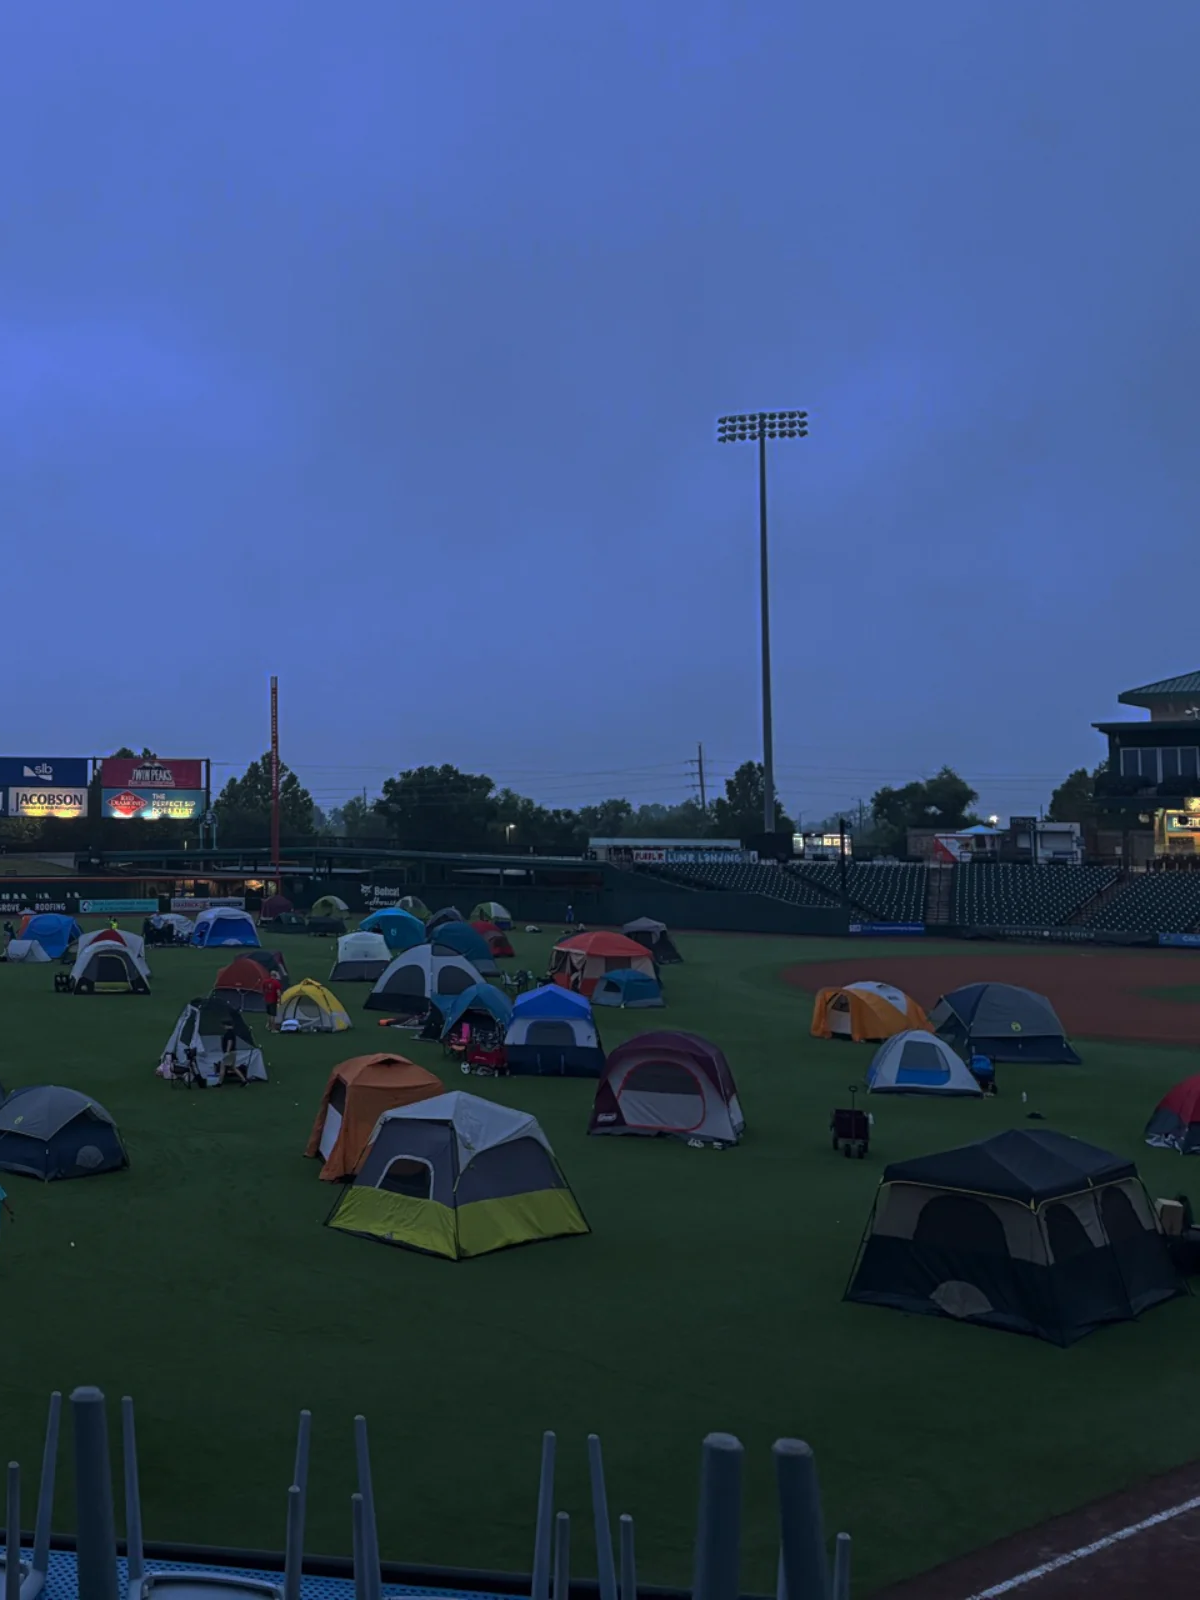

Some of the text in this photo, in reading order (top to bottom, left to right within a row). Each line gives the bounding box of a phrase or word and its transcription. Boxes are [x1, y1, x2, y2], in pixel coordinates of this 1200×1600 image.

[34, 763, 54, 775] slb
[132, 768, 172, 782] TWIN PEAKS
[16, 792, 83, 812] JACOBSON
[374, 886, 400, 897] Bobcat
[35, 903, 66, 911] ROOFING
